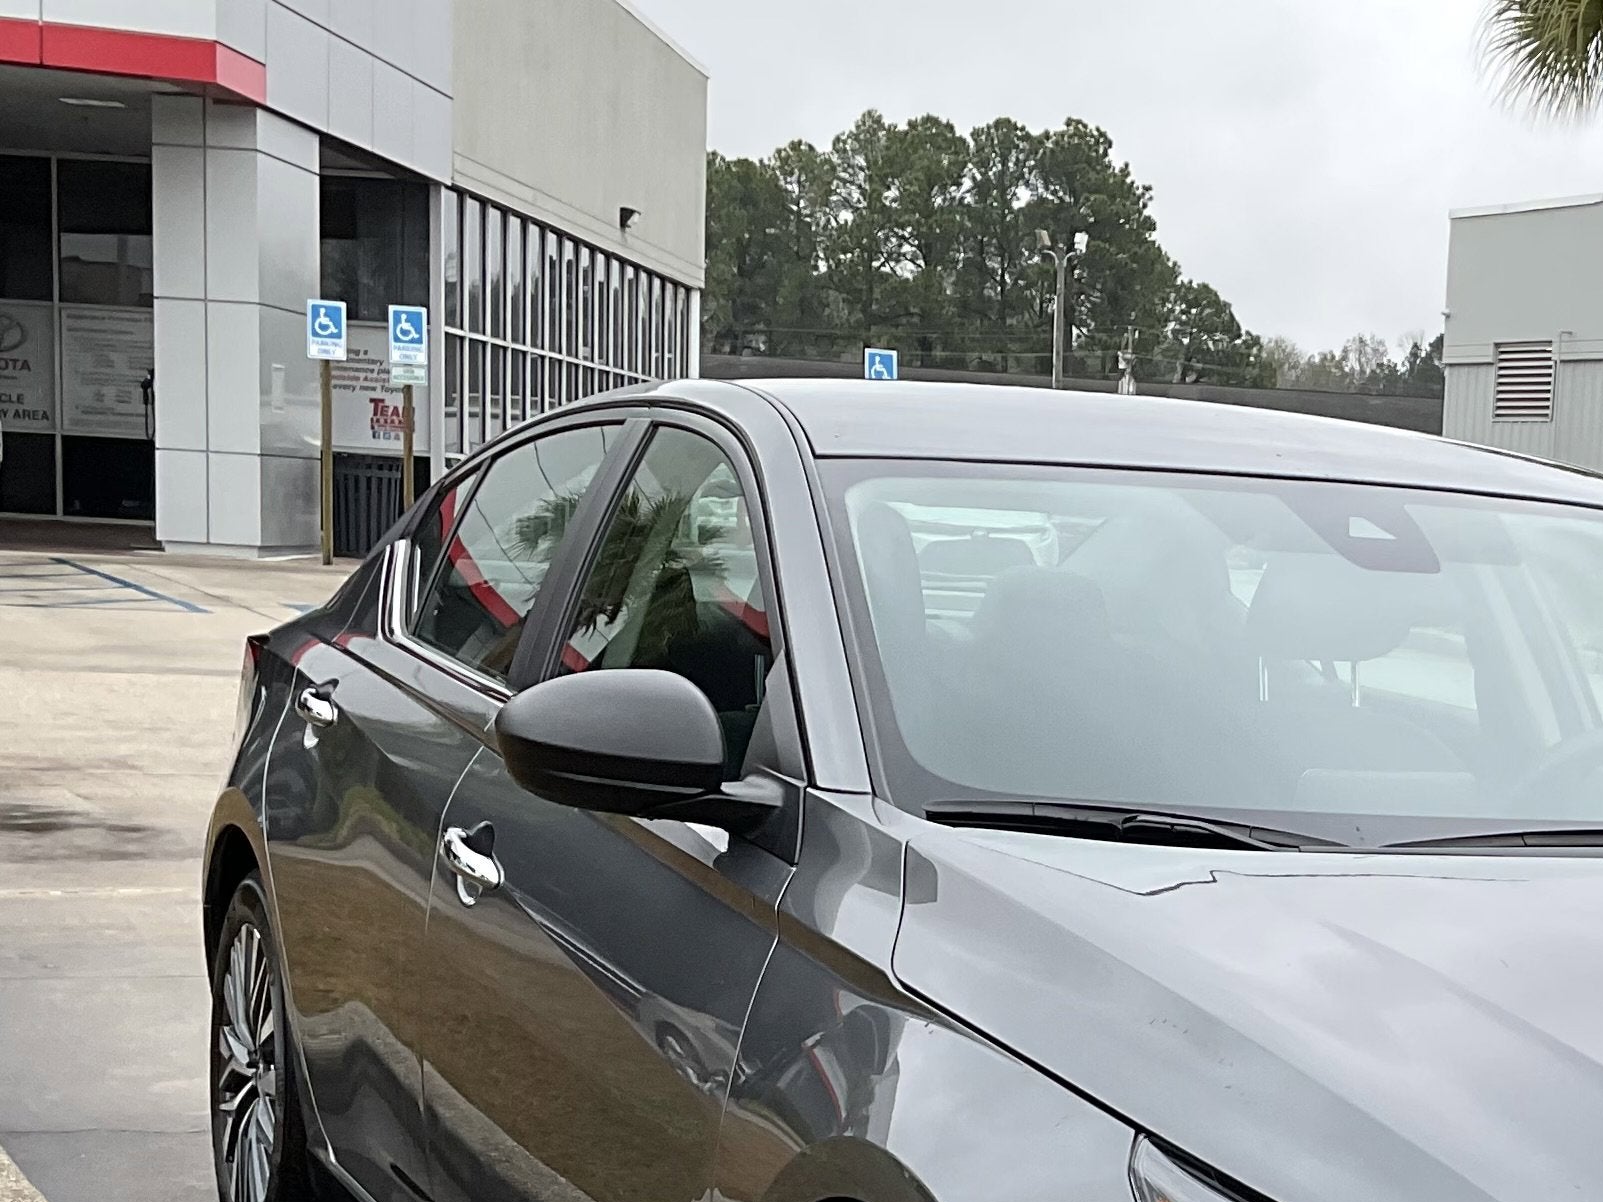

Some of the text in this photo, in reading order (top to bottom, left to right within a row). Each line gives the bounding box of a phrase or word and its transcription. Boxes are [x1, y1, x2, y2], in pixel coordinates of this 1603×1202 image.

[312, 339, 343, 348] PARKING
[317, 348, 337, 356] ONLY
[393, 344, 424, 353] PARKING
[398, 353, 418, 361] ONLY
[13, 408, 50, 421] AREA
